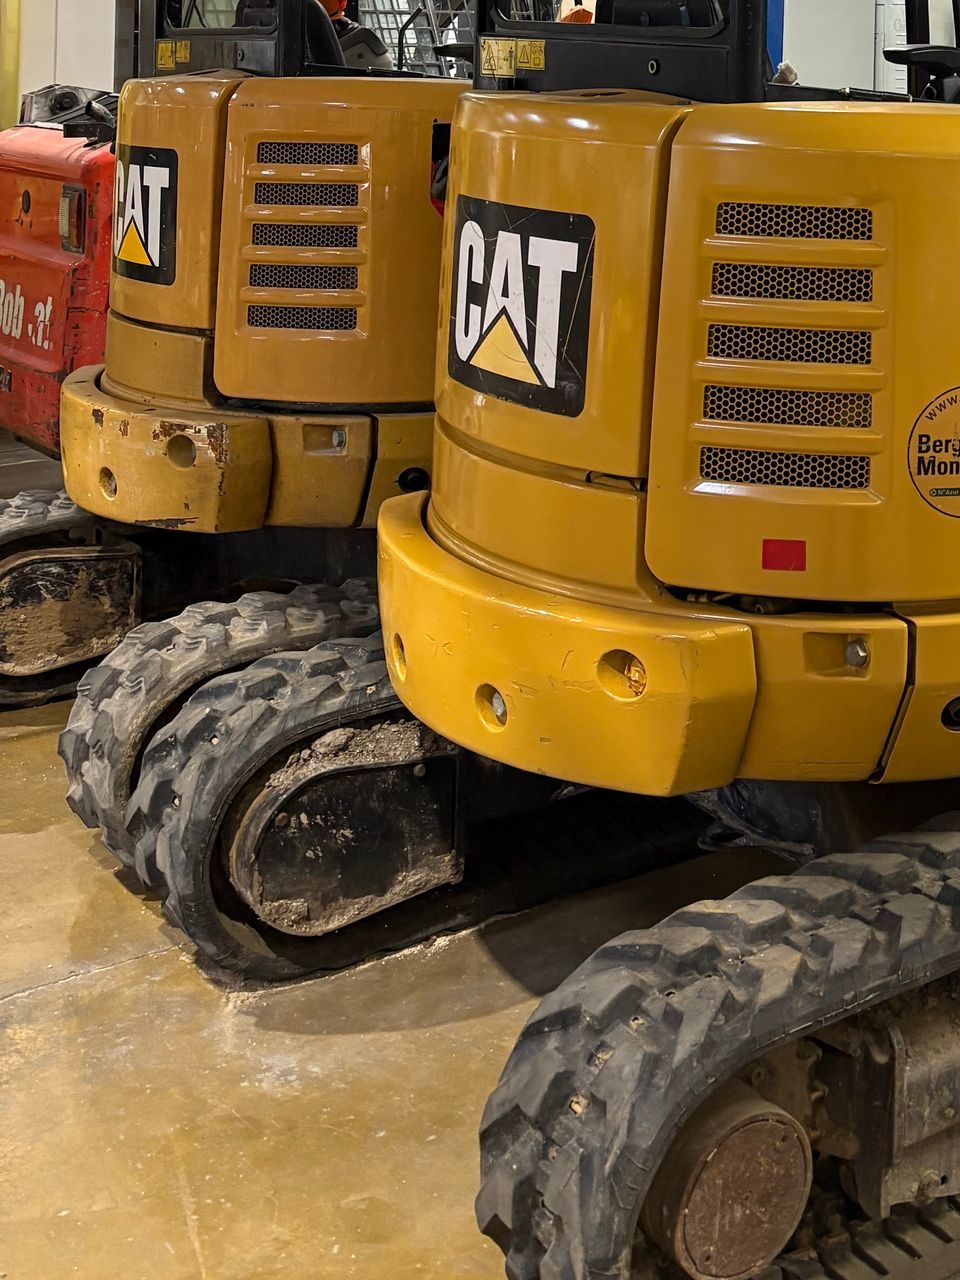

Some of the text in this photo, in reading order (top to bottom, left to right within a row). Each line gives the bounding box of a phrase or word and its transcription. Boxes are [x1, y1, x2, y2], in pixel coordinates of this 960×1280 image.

[114, 160, 170, 267] CAT
[0, 279, 53, 350] obat
[455, 220, 579, 388] CAT
